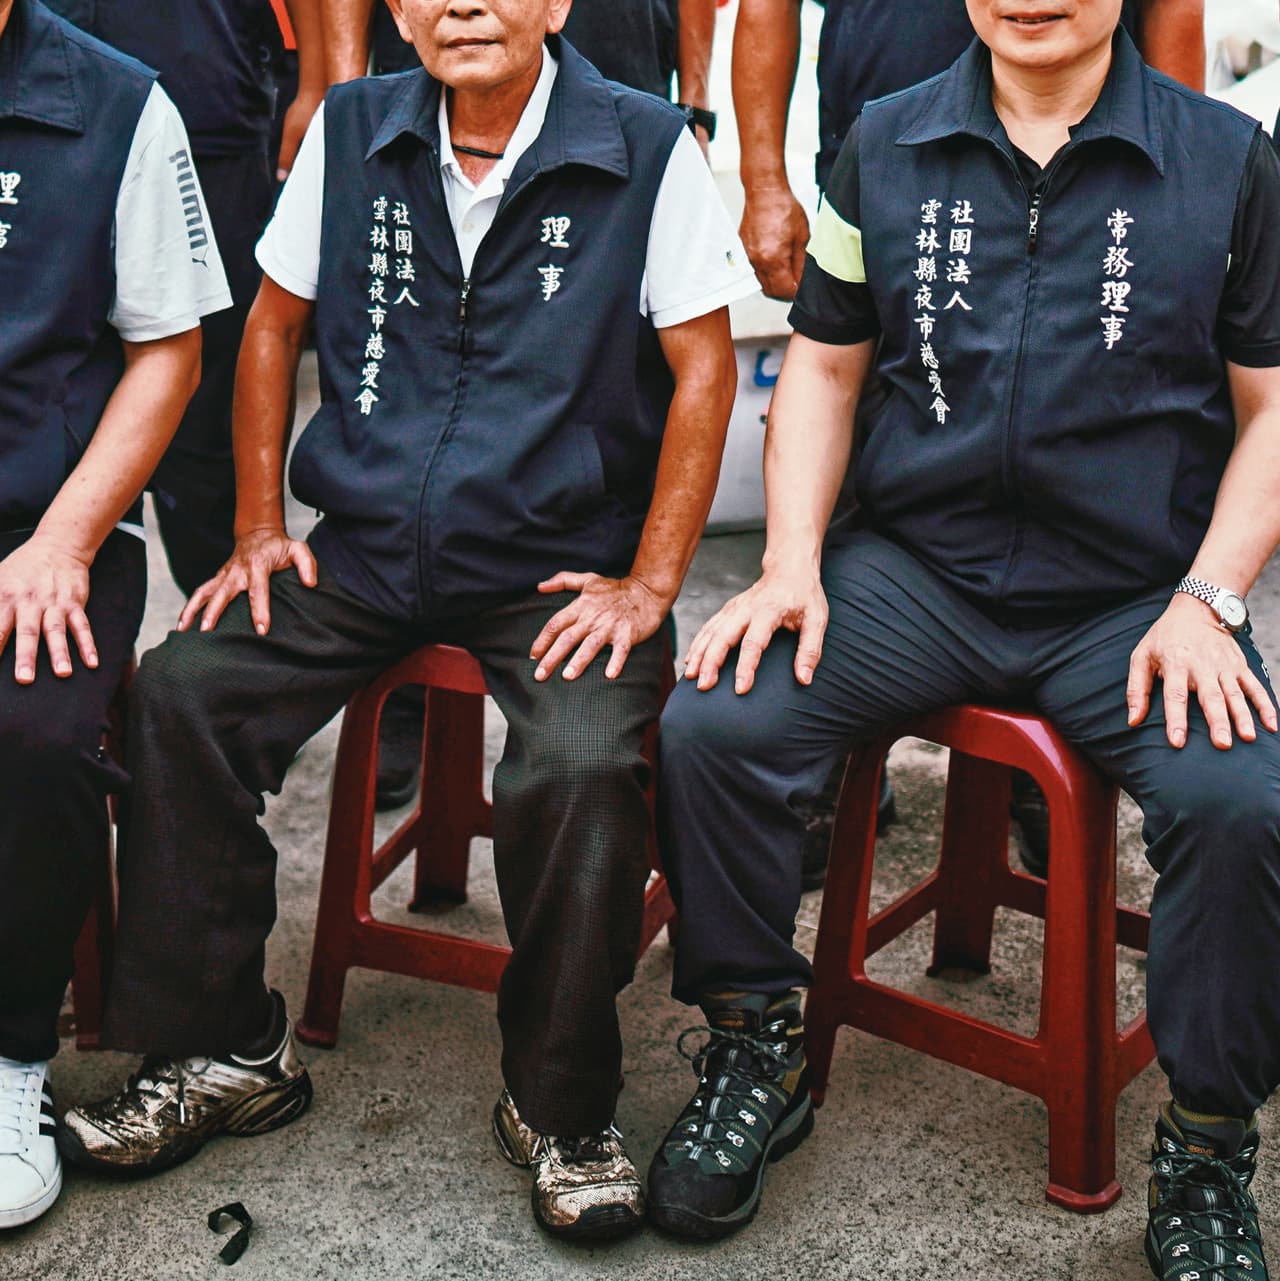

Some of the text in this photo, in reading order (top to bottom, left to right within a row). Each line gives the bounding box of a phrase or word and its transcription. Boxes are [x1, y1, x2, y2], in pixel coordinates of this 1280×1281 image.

[354, 196, 389, 416] 雲林縣夜市慈愛會
[391, 202, 420, 307] 社團法人
[537, 216, 571, 302] 理事
[913, 198, 951, 424] 雲林縣夜市慈愛會
[943, 199, 975, 311] 社團法人
[1100, 207, 1135, 351] 常務理事
